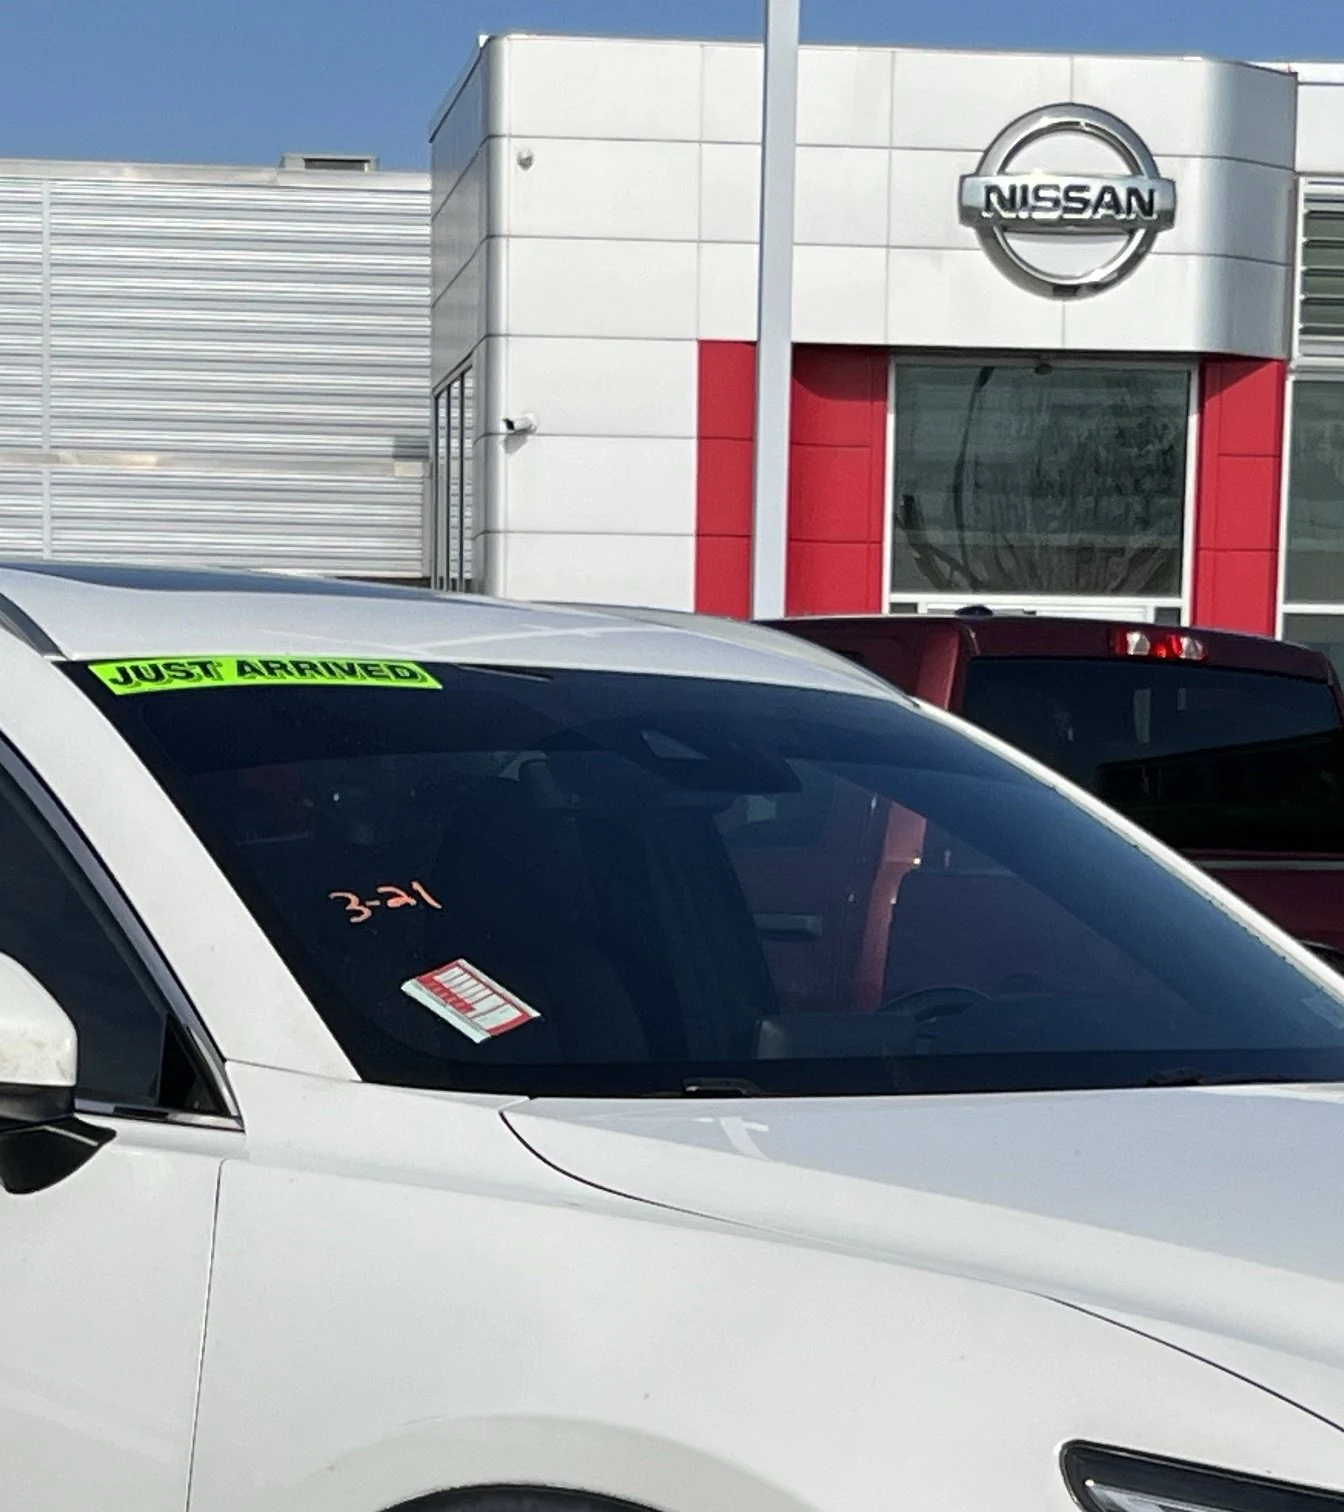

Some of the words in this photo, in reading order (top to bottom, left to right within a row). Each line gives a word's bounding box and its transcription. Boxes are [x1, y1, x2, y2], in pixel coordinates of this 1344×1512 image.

[983, 183, 1157, 219] NISSAN
[108, 660, 224, 688] JUST
[234, 659, 429, 684] ARRIVED
[328, 880, 442, 923] 3-21
